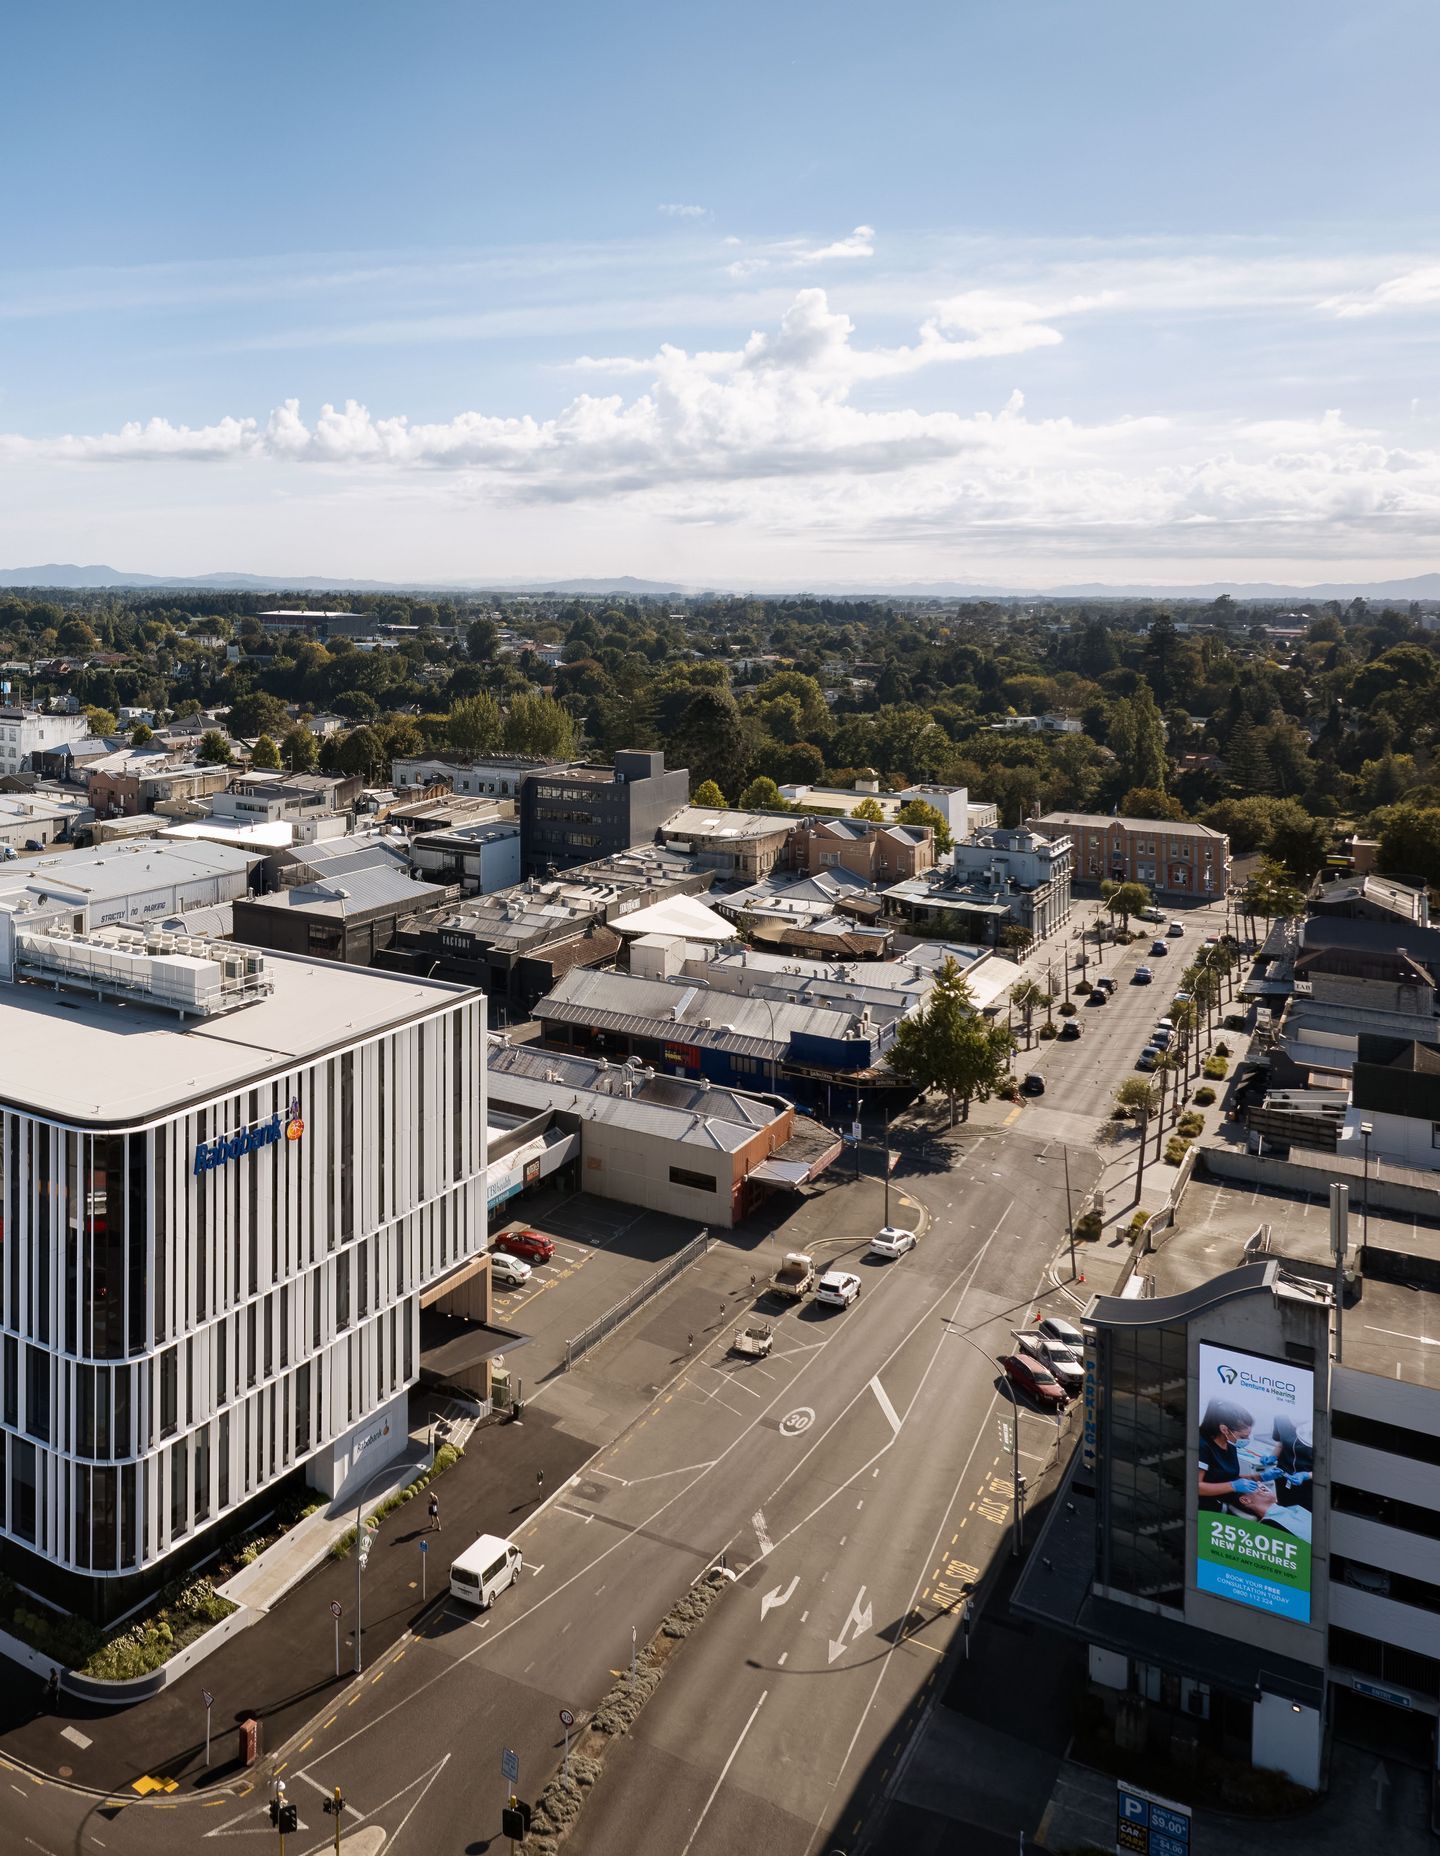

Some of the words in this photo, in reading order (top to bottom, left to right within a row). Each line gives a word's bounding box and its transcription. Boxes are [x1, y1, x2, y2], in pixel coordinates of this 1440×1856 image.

[101, 911, 125, 923] STRICTLY
[144, 902, 166, 913] PARKING
[442, 936, 470, 948] FACTORY
[194, 1113, 282, 1175] Rabobank
[1240, 1371, 1296, 1392] CLINICO
[1241, 1380, 1265, 1392] Denture
[1271, 1388, 1296, 1400] Hearing
[1085, 1361, 1095, 1444] PARKING
[787, 1415, 808, 1428] 30
[357, 1429, 381, 1453] Rabobank
[977, 1497, 1010, 1524] STOP
[1211, 1537, 1235, 1551] NEW
[1238, 1545, 1297, 1570] DENTURES
[945, 1560, 979, 1584] BUS
[1216, 1577, 1266, 1597] CONSULTATION
[1268, 1592, 1289, 1604] TODAY
[1225, 1573, 1243, 1583] BOOK
[1245, 1579, 1263, 1590] YOUR
[1264, 1585, 1281, 1595] FREE
[1232, 1588, 1248, 1598] 0800
[1249, 1592, 1261, 1602] 112
[1125, 1798, 1142, 1817] P
[1120, 1824, 1140, 1837] CAR
[1120, 1832, 1145, 1847] PARK
[1159, 1839, 1183, 1854] $4.00
